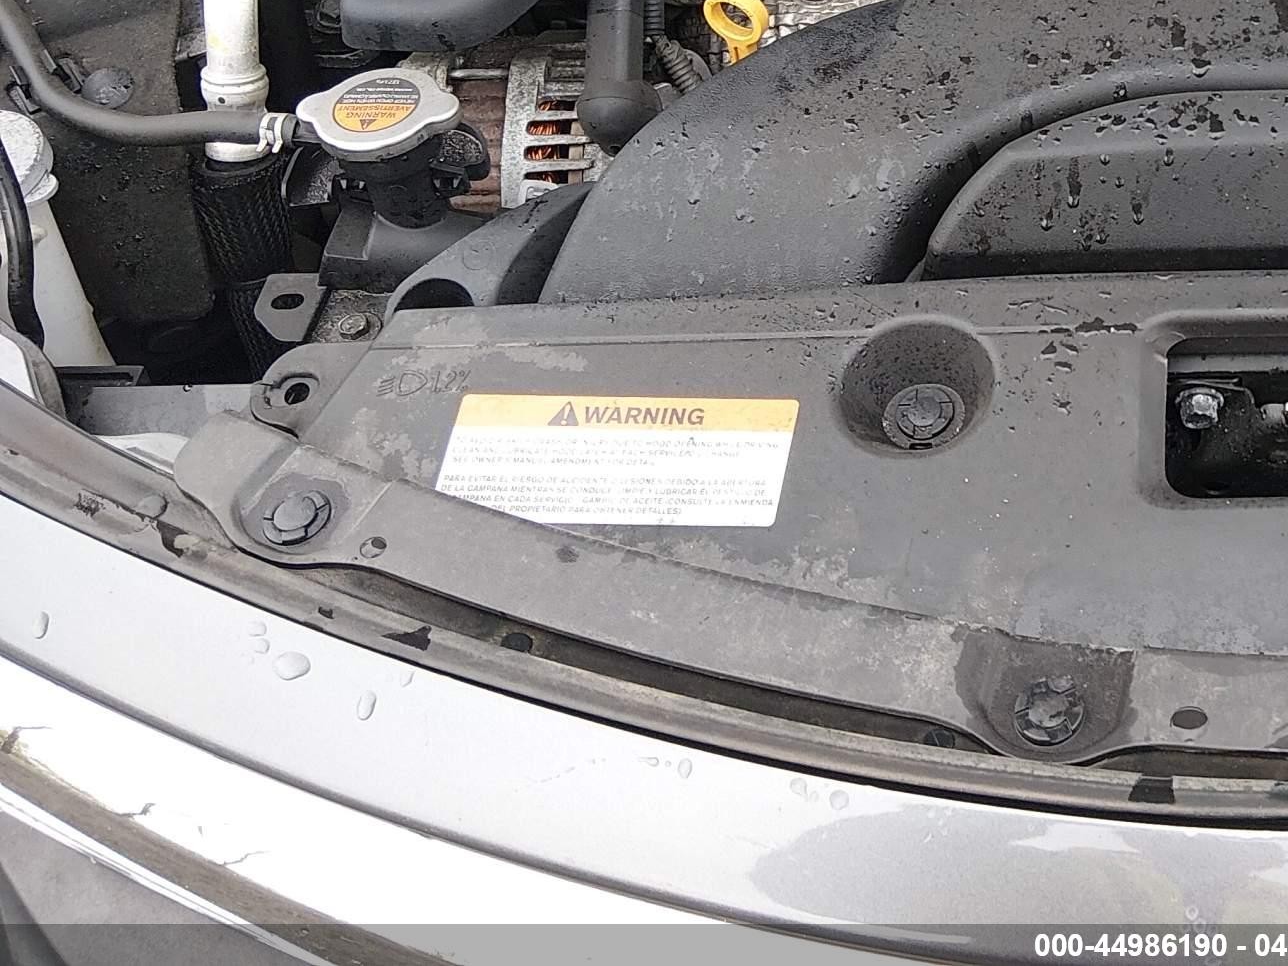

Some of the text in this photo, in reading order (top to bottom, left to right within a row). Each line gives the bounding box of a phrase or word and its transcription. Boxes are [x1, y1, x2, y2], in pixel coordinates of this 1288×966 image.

[345, 111, 397, 119] WARNING
[585, 406, 705, 425] WARNING
[443, 474, 465, 483] PARA
[467, 475, 496, 483] EVITAR
[549, 476, 559, 484] DE
[440, 484, 452, 492] DE
[454, 484, 465, 492] LA
[467, 484, 509, 493] CAMPANA
[510, 485, 555, 494] MIENTRAS
[556, 486, 567, 494] SE
[615, 487, 646, 495] IMPIE
[654, 487, 697, 496] LUBRICAR
[493, 494, 505, 502] EN
[507, 494, 531, 503] CADA
[632, 497, 663, 505] ACEITE
[508, 504, 566, 514] PROPIETARIO
